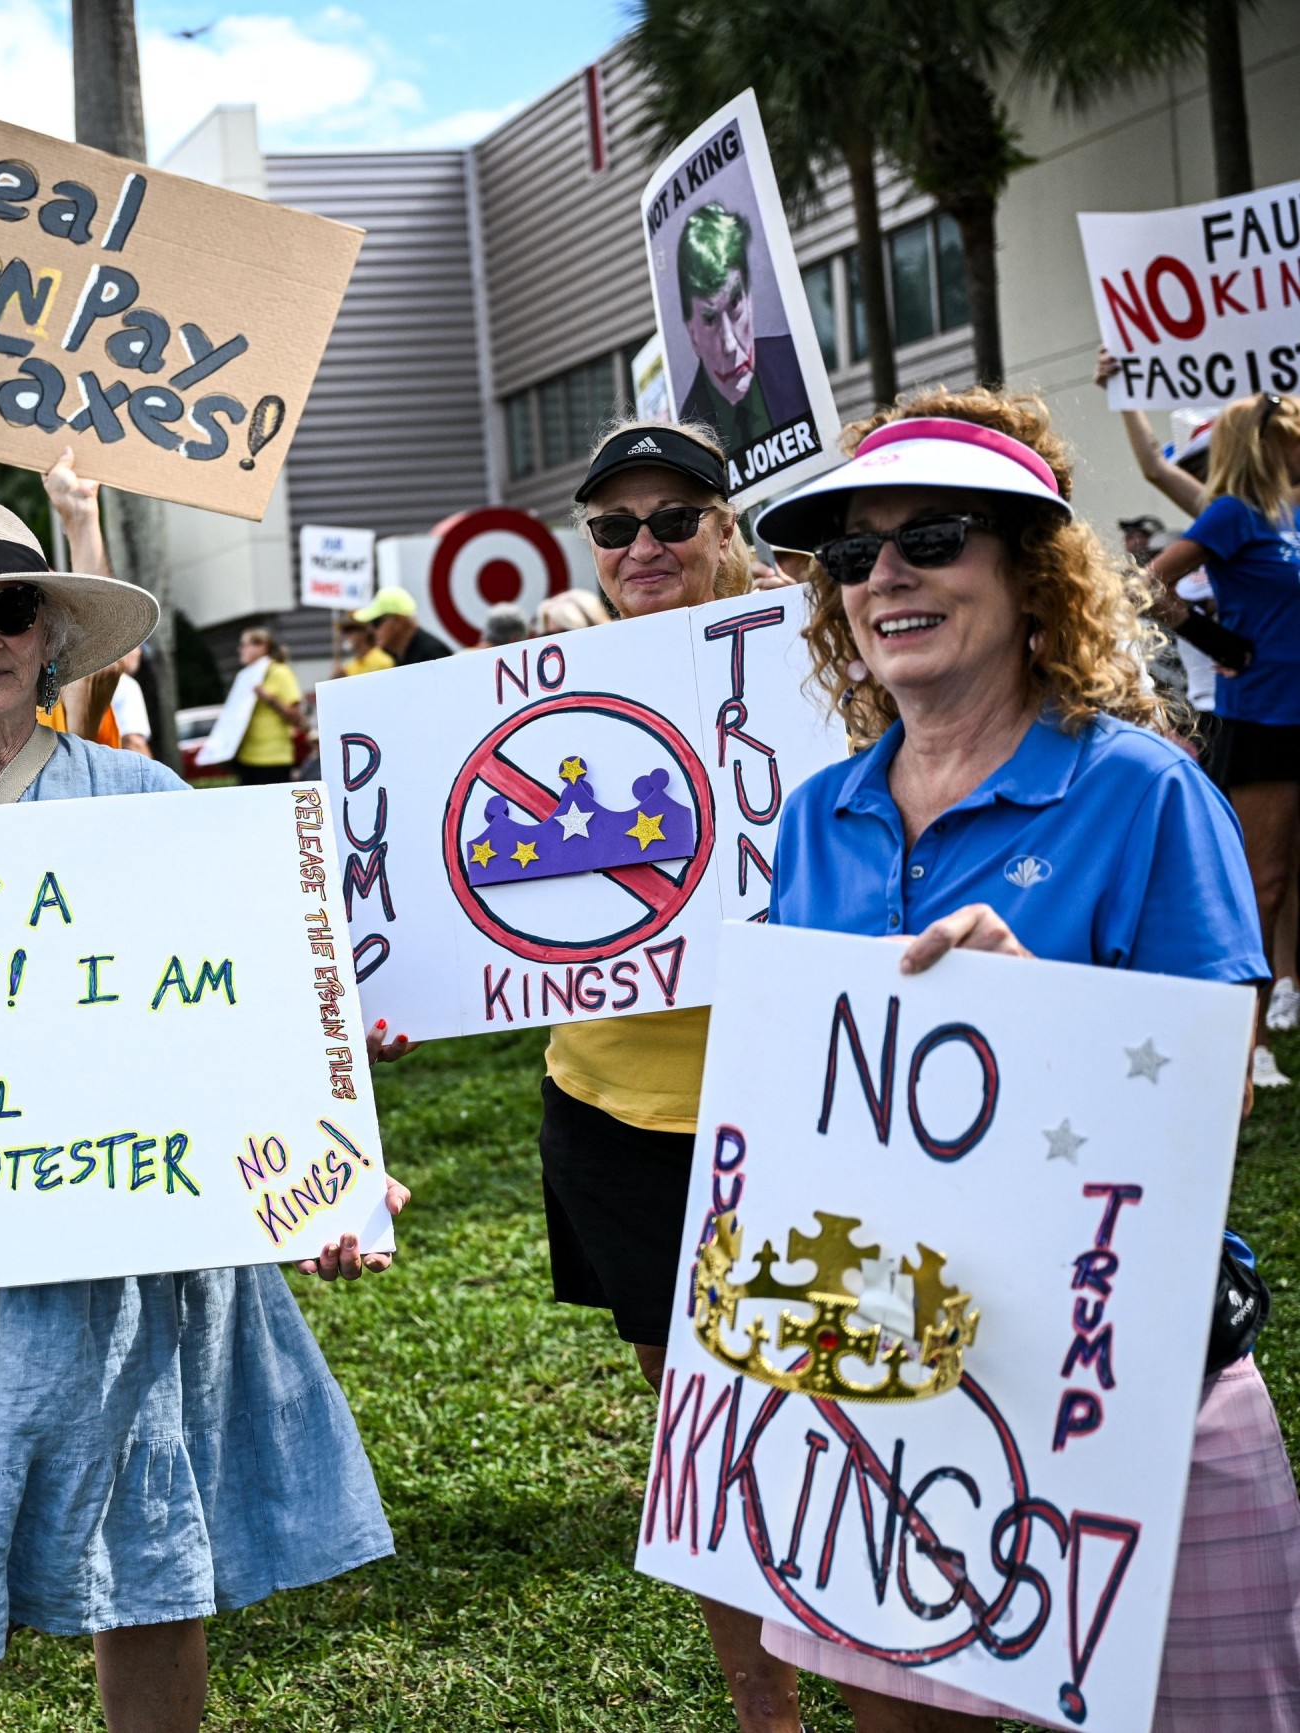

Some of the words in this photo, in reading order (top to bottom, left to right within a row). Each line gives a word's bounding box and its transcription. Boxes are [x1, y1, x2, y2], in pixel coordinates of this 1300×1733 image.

[647, 189, 669, 240] NOT
[673, 177, 685, 208] A
[686, 129, 739, 193] KING
[1202, 196, 1300, 263] FAU
[61, 264, 248, 390] Pay
[1101, 254, 1206, 354] NO
[1120, 343, 1300, 399] FASCIS
[627, 445, 662, 455] adidas
[728, 459, 743, 491] A
[744, 421, 816, 480] JOKER
[494, 642, 566, 706] NO
[704, 605, 785, 924] TRU
[291, 787, 326, 902] RELEASE
[340, 732, 396, 985] DUMP
[29, 871, 73, 927] A
[304, 908, 335, 961] THE
[77, 955, 119, 1006] I
[151, 954, 238, 1011] AM
[483, 935, 687, 1023] KINGS!
[816, 990, 1001, 1164] NO
[236, 1135, 287, 1190] NO
[255, 1118, 371, 1244] KINGS!
[1051, 1184, 1144, 1453] TRUMP
